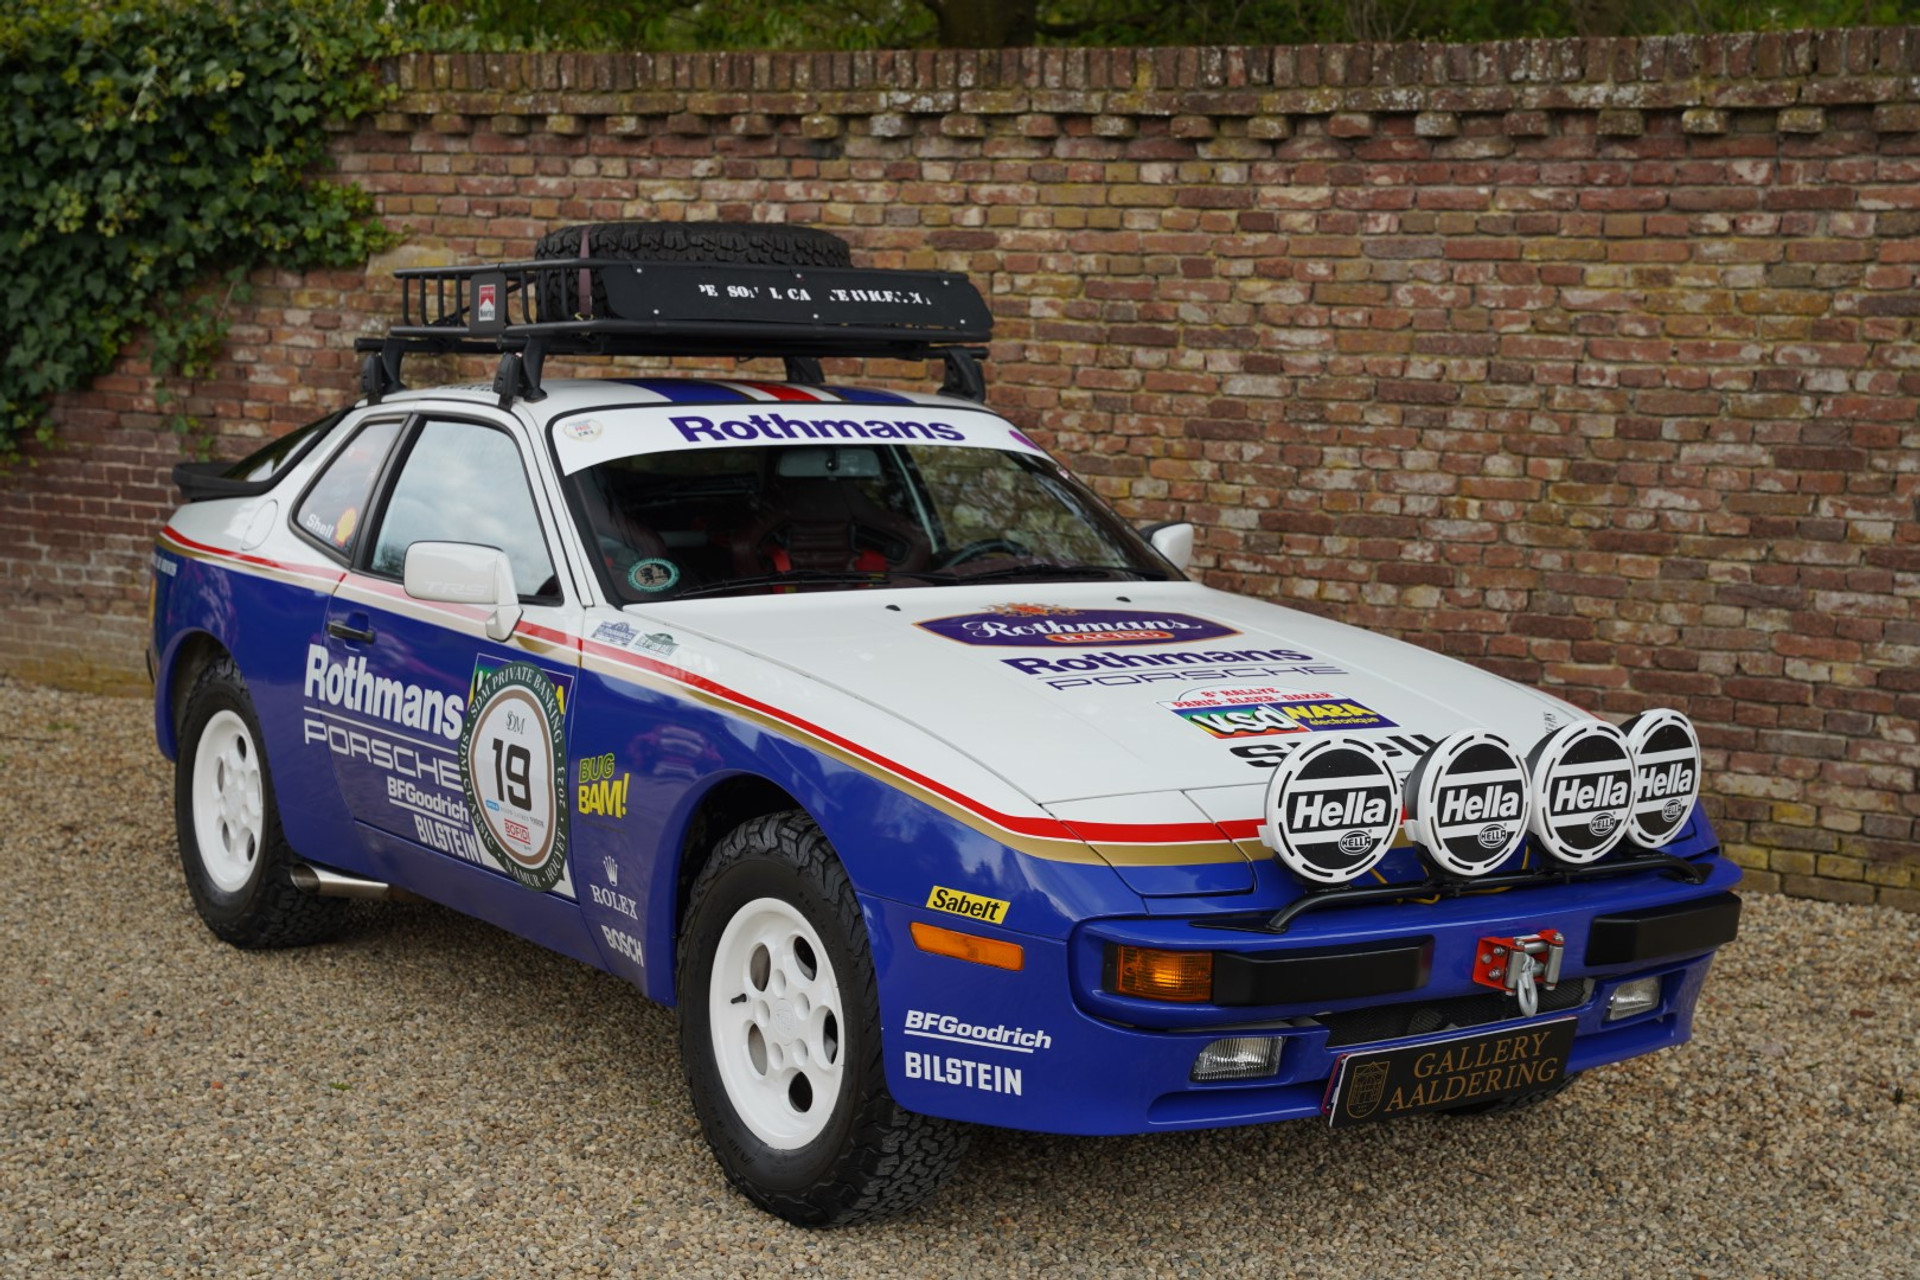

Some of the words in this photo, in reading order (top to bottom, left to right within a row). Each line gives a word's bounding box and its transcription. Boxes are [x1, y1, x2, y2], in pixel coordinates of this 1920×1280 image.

[668, 413, 966, 442] Rothmans
[306, 513, 334, 539] Shell
[962, 615, 1202, 638] Rothmans
[1059, 632, 1160, 642] RACING
[1000, 647, 1313, 675] Rothmans
[1045, 665, 1349, 691] PORSCHE
[304, 643, 465, 741] Rothmans
[470, 684, 491, 718] SDM
[492, 666, 534, 690] PRIVATE
[533, 674, 563, 743] BANKING
[1220, 687, 1280, 697] RALLYE
[304, 718, 465, 793] PORSCHE
[579, 753, 615, 783] BUG
[492, 738, 532, 812] 19
[1553, 775, 1628, 813] Hella
[1638, 763, 1693, 799] Hella
[386, 775, 469, 823] BFGoodrich
[463, 777, 495, 850] CLASSIC
[578, 773, 630, 818] BAM!
[1292, 791, 1387, 829] Hella
[1441, 785, 1520, 824] Hella
[413, 813, 483, 865] BILSTEIN
[1341, 836, 1372, 848] HELLA
[1480, 830, 1507, 841] HELLA
[1591, 817, 1616, 829] HELLA
[590, 884, 639, 921] ROLEX
[933, 889, 1001, 921] Sabelt
[601, 924, 645, 968] BOSCH
[904, 1010, 1052, 1049] BFGoodrich
[905, 1051, 1022, 1096] BILSTEIN
[1413, 1031, 1552, 1079] GALLERY
[1383, 1057, 1559, 1112] AALDERING
